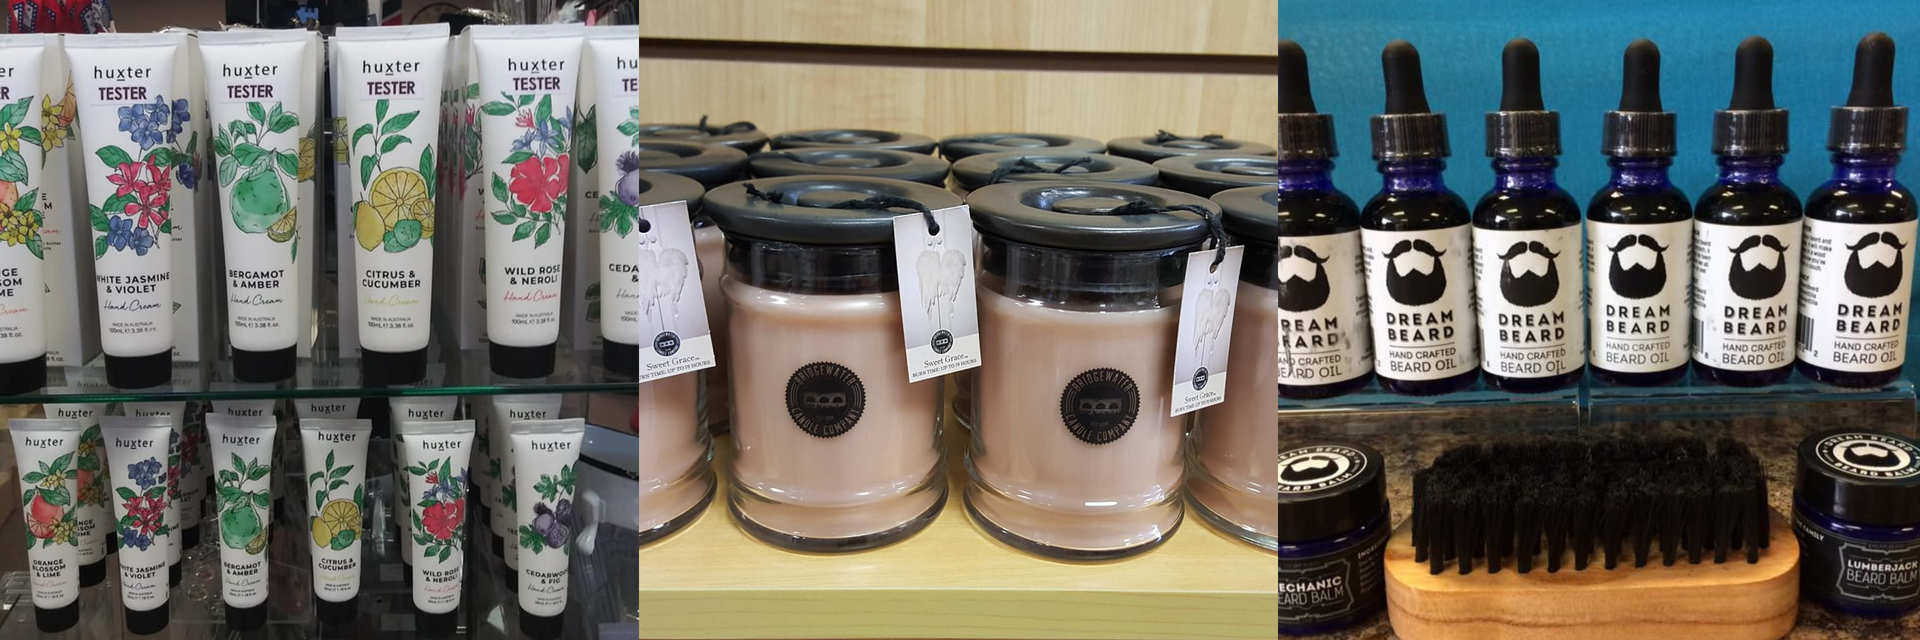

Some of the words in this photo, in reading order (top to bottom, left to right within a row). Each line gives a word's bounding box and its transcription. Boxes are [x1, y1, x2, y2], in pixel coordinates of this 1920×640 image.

[223, 63, 278, 79] huxter
[363, 60, 420, 75] huxter
[508, 58, 565, 74] huxter
[94, 66, 152, 81] huxter
[367, 82, 416, 95] TESTER
[512, 77, 561, 91] TESTER
[99, 86, 148, 100] TESTER
[227, 84, 274, 99] TESTER
[229, 269, 284, 280] BERGAMOT
[366, 270, 406, 279] CITRUS
[408, 270, 416, 278] &
[504, 266, 536, 276] WILD
[539, 264, 560, 274] ROSE
[126, 272, 170, 284] JASMINE
[232, 280, 238, 288] &
[240, 280, 280, 289] AMBER
[362, 278, 421, 289] CUCUMBER
[510, 276, 518, 284] &
[522, 274, 558, 285] NEROLI
[106, 286, 112, 294] &
[116, 284, 156, 294] VIOLET
[231, 292, 252, 304] Hand
[503, 290, 532, 302] Hand
[104, 300, 128, 311] Hand
[1606, 304, 1671, 319] DREAM
[1724, 304, 1788, 320] DREAM
[1838, 302, 1902, 318] DREAM
[1281, 316, 1338, 332] REAM
[1386, 310, 1454, 326] DREAM
[1498, 311, 1565, 328] DREAM
[1606, 320, 1670, 335] BEARD
[1724, 320, 1787, 336] BEARD
[1836, 319, 1901, 334] BEARD
[1282, 333, 1339, 348] EARD
[1388, 326, 1454, 343] BEARD
[1500, 327, 1565, 343] BEARD
[1606, 341, 1630, 352] HAND
[1632, 340, 1671, 352] CRAFTED
[1722, 342, 1749, 352] HAND
[1750, 340, 1787, 353] CRAFTED
[1834, 340, 1862, 352] HAND
[1863, 340, 1900, 352] CRAFTED
[1278, 356, 1296, 366] AND
[1298, 354, 1342, 366] CRAFTED
[1390, 350, 1413, 360] HAND
[1416, 347, 1456, 359] CRAFTED
[1500, 350, 1525, 361] HAND
[1527, 348, 1566, 360] CRAFTED
[1606, 352, 1648, 365] BEARD
[1650, 352, 1670, 364] OIL
[1722, 352, 1765, 366] BEARD
[1768, 351, 1785, 364] OIL
[1814, 350, 1818, 358] 2
[1833, 352, 1878, 365] BEARD
[1880, 352, 1898, 364] OIL
[646, 360, 670, 371] Sweet
[691, 360, 711, 368] HOURS
[924, 358, 943, 368] Sweet
[1390, 360, 1432, 373] BEARD
[1435, 359, 1457, 372] OIL
[1500, 360, 1542, 374] BEARD
[1546, 360, 1566, 372] OIL
[794, 364, 856, 387] BRIDGEWATER
[912, 370, 926, 378] BURN
[1319, 365, 1342, 378] OIL
[1072, 370, 1133, 392] BRIDGEWATER
[1184, 394, 1198, 404] Sweet
[58, 408, 94, 419] huxter
[228, 406, 263, 417] huxter
[311, 404, 346, 414] huxter
[408, 408, 444, 419] huxter
[510, 409, 547, 420] huxter
[791, 407, 818, 434] CANDLE
[824, 408, 860, 435] COMPANY
[1066, 413, 1094, 440] CANDLE
[1097, 414, 1134, 442] COMPANY
[26, 436, 64, 448] huxter
[222, 434, 260, 446] huxter
[318, 431, 356, 443] huxter
[1825, 434, 1863, 446] DREAM
[1870, 434, 1914, 452] BEARD
[116, 438, 154, 450] huxter
[422, 440, 461, 451] huxter
[531, 440, 571, 452] huxter
[1316, 447, 1356, 457] BEARD
[1834, 462, 1878, 476] BEARD
[1884, 466, 1917, 477] BALM
[1319, 472, 1352, 488] BALM
[1802, 526, 1824, 541] FAMILY
[32, 558, 64, 566] ORANGE
[32, 564, 66, 572] BLOSSOM
[136, 560, 166, 573] JASMINE
[224, 560, 261, 570] BERGAMOT
[318, 562, 356, 571] CUCUMBER
[1848, 560, 1918, 572] LUMBERJACK
[232, 568, 258, 576] AMBER
[422, 569, 442, 577] WILD
[526, 568, 568, 578] CEDARWOO
[1846, 568, 1886, 586] BEARD
[1890, 570, 1918, 586] BALM
[1279, 576, 1342, 592] ECHANIC
[1278, 592, 1308, 606] EARD
[1311, 586, 1344, 603] BALM
